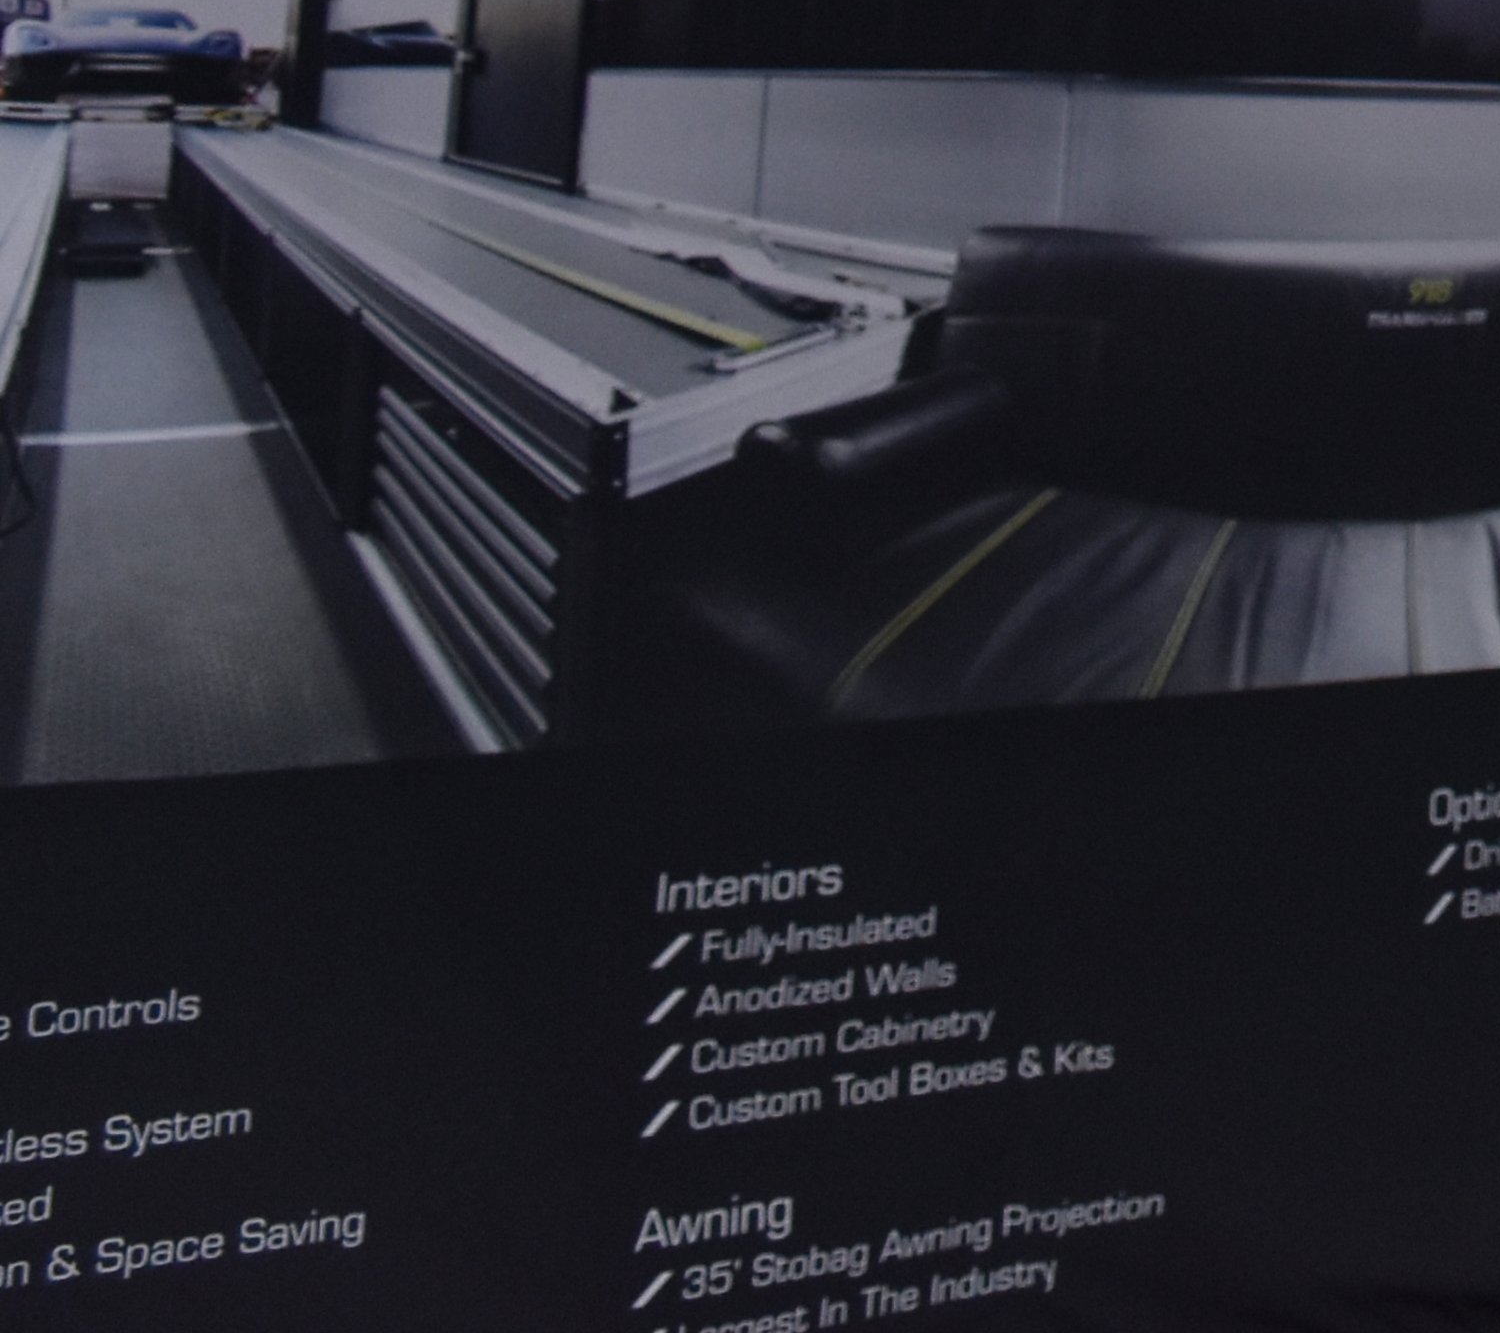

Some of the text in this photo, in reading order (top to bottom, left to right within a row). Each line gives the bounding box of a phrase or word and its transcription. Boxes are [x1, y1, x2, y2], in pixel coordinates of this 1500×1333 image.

[656, 861, 844, 914] Interiors
[701, 906, 938, 966] Fully-Insulated
[27, 988, 201, 1037] Controls
[695, 957, 957, 1018] Anodized Walls
[690, 1007, 996, 1076] Custom Cabinetry
[687, 1038, 1116, 1132] Custom Tool Boxes & Kits
[103, 1106, 253, 1158] System
[47, 1245, 80, 1283] &
[95, 1227, 225, 1279] Space
[238, 1208, 367, 1256] Saving
[634, 1193, 794, 1255] Awning
[680, 1191, 1165, 1301] 35' Stobag Awning Projection
[818, 1296, 850, 1329] In
[860, 1283, 920, 1321] The
[929, 1259, 1059, 1306] Industry
